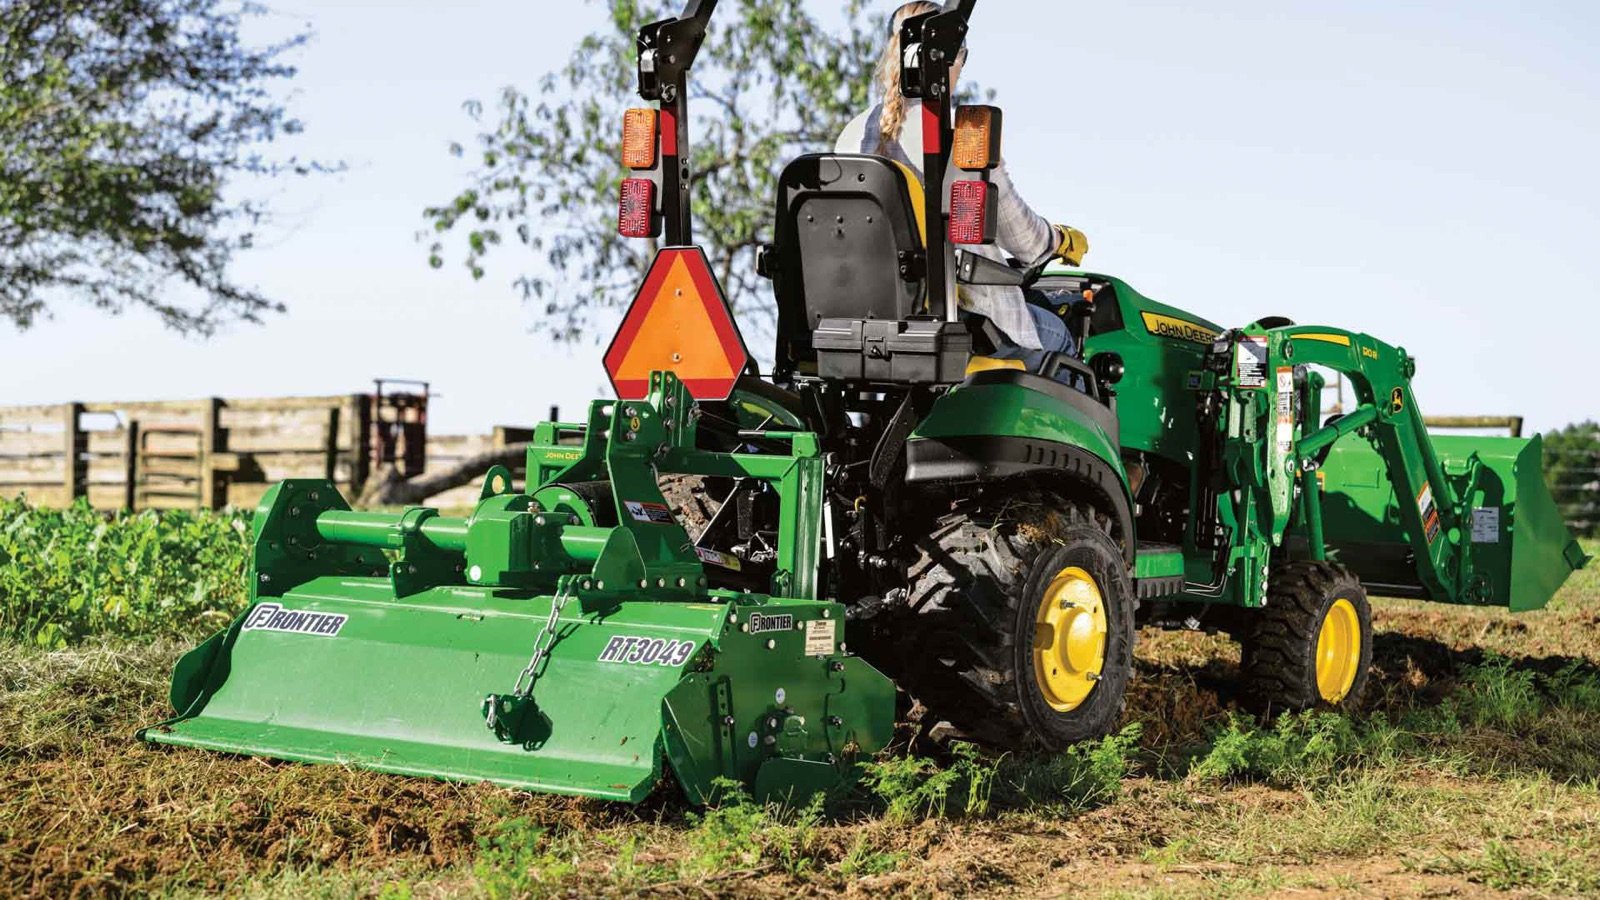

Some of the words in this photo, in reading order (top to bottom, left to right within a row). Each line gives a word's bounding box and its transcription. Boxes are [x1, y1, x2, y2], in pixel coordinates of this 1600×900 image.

[1154, 319, 1182, 336] JOHN
[243, 604, 346, 635] FRONTIER
[750, 613, 792, 633] FRONTIER
[599, 636, 694, 666] RT3049
